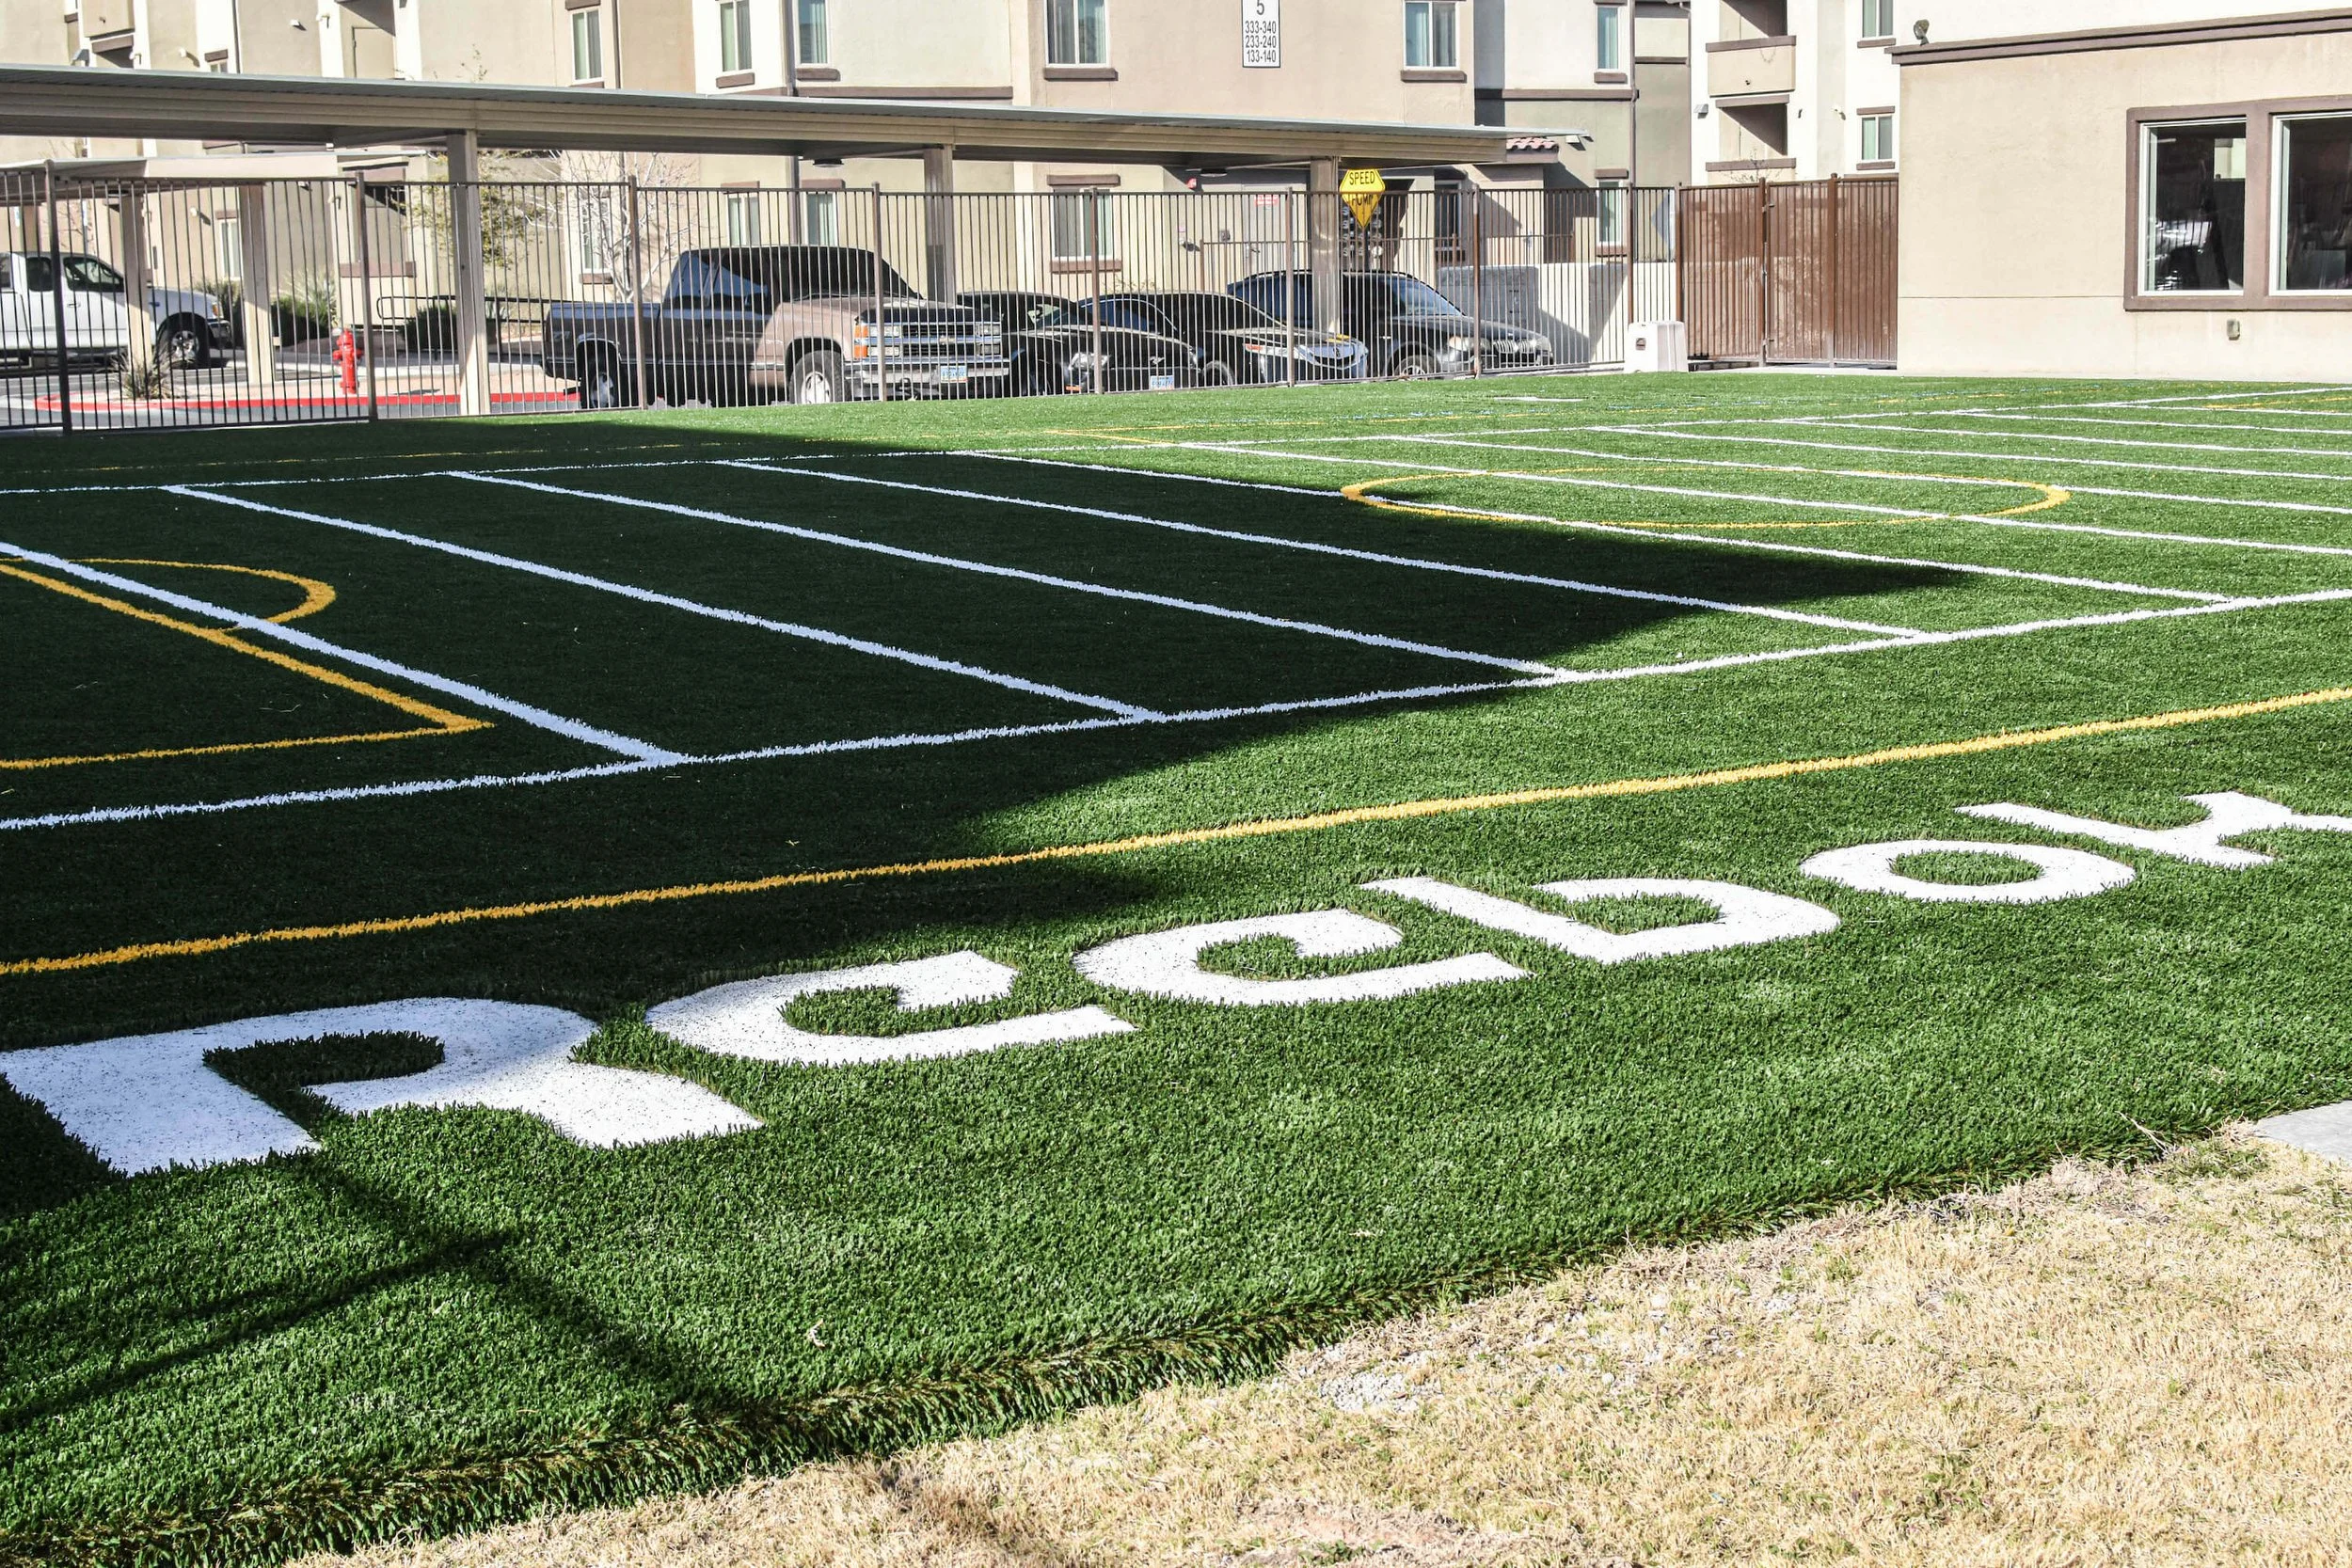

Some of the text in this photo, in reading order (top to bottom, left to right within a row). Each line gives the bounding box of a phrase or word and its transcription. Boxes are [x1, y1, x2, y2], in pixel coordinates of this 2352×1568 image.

[1256, 0, 1265, 16] 5
[1245, 20, 1277, 34] 333-340
[1245, 35, 1277, 48] 233-240
[1247, 49, 1277, 63] 133-140
[1349, 171, 1375, 185] SPEED
[0, 790, 2352, 1177] Reebok
